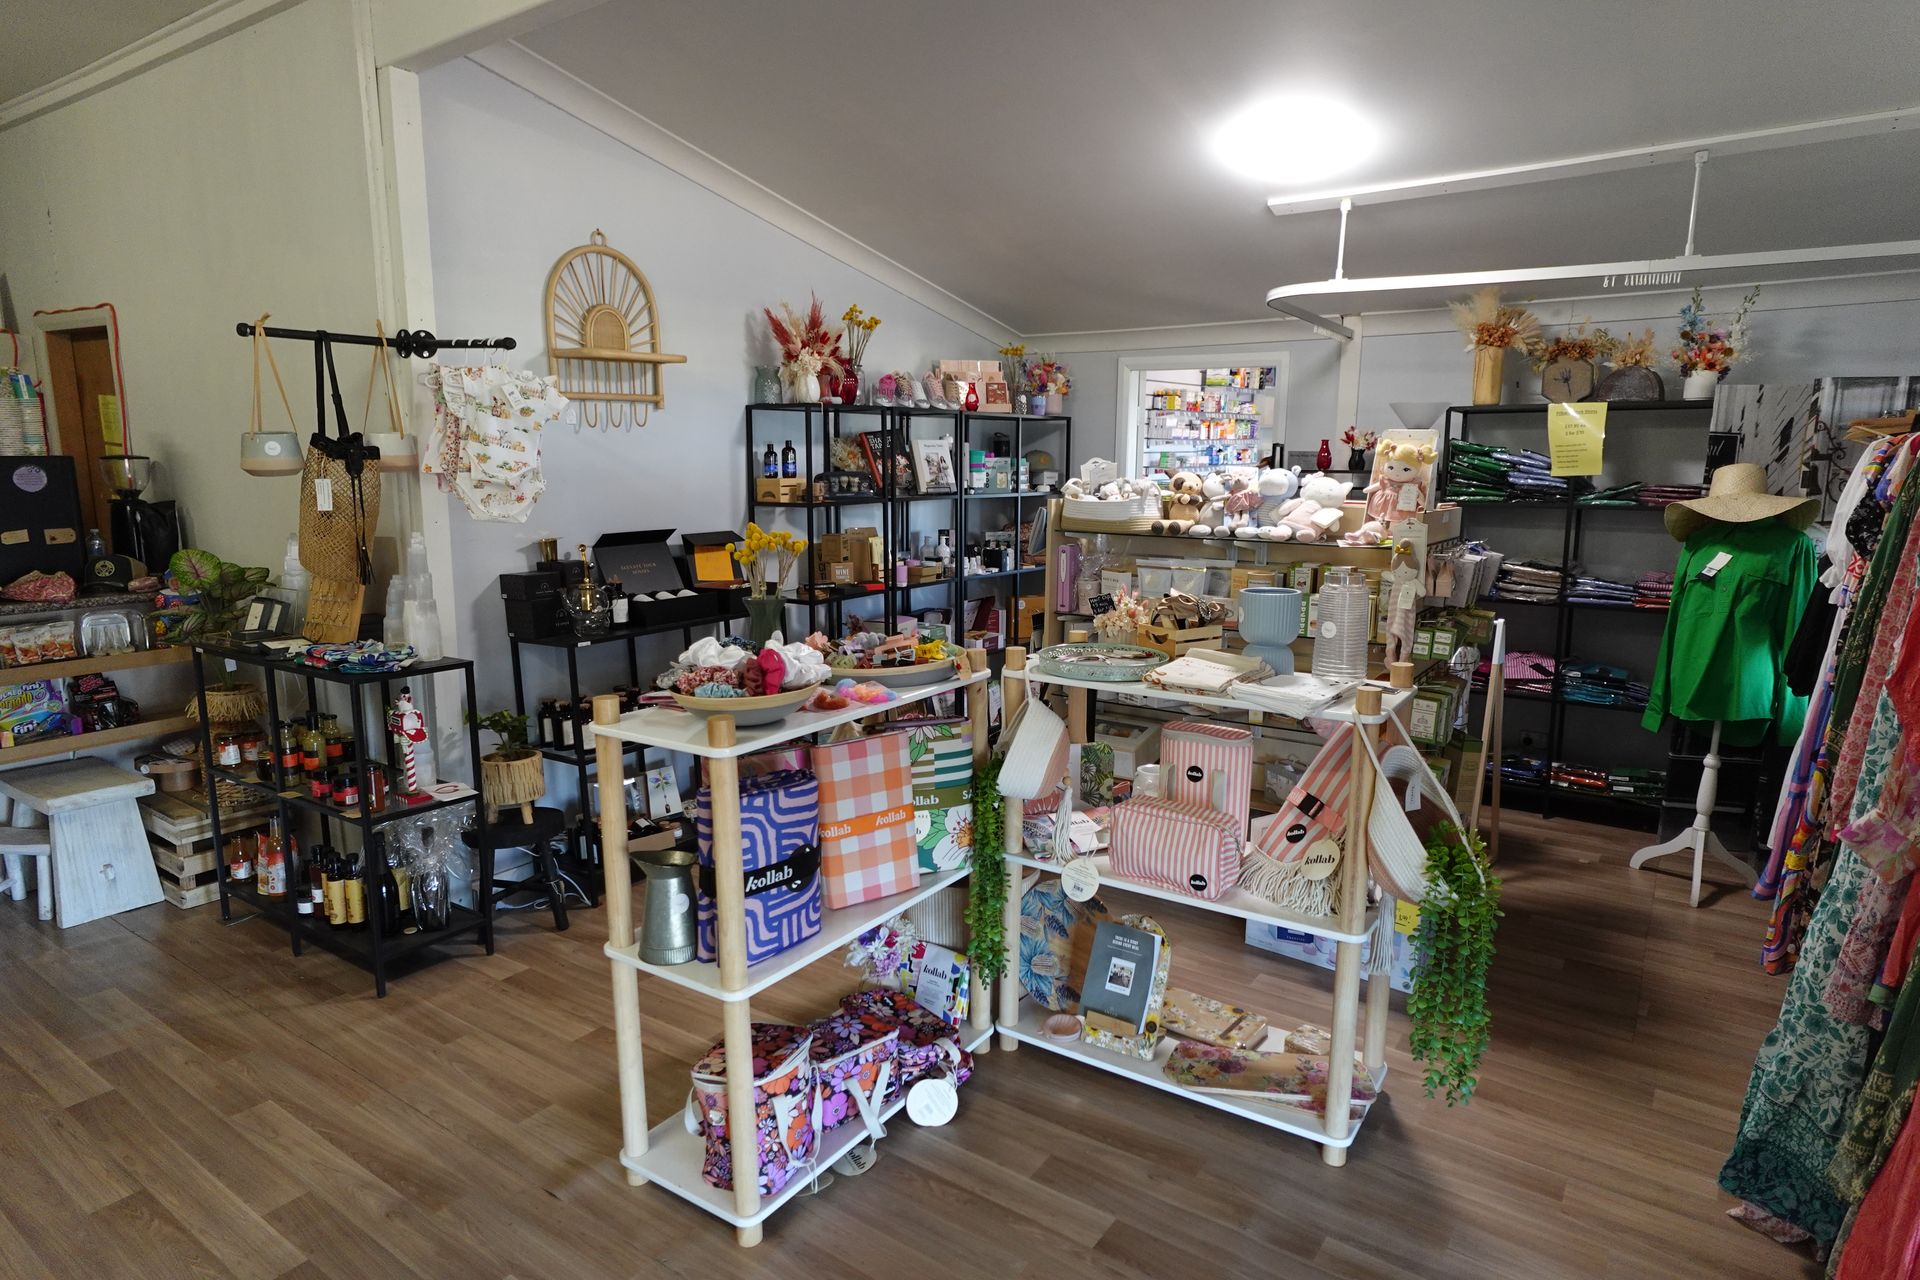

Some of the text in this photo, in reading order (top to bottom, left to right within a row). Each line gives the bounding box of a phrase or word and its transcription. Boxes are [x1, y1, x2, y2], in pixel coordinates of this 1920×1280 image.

[13, 720, 38, 734] fini
[875, 809, 906, 826] kollab
[1304, 854, 1335, 865] kollab
[745, 865, 793, 893] kollab
[923, 964, 947, 980] kollab
